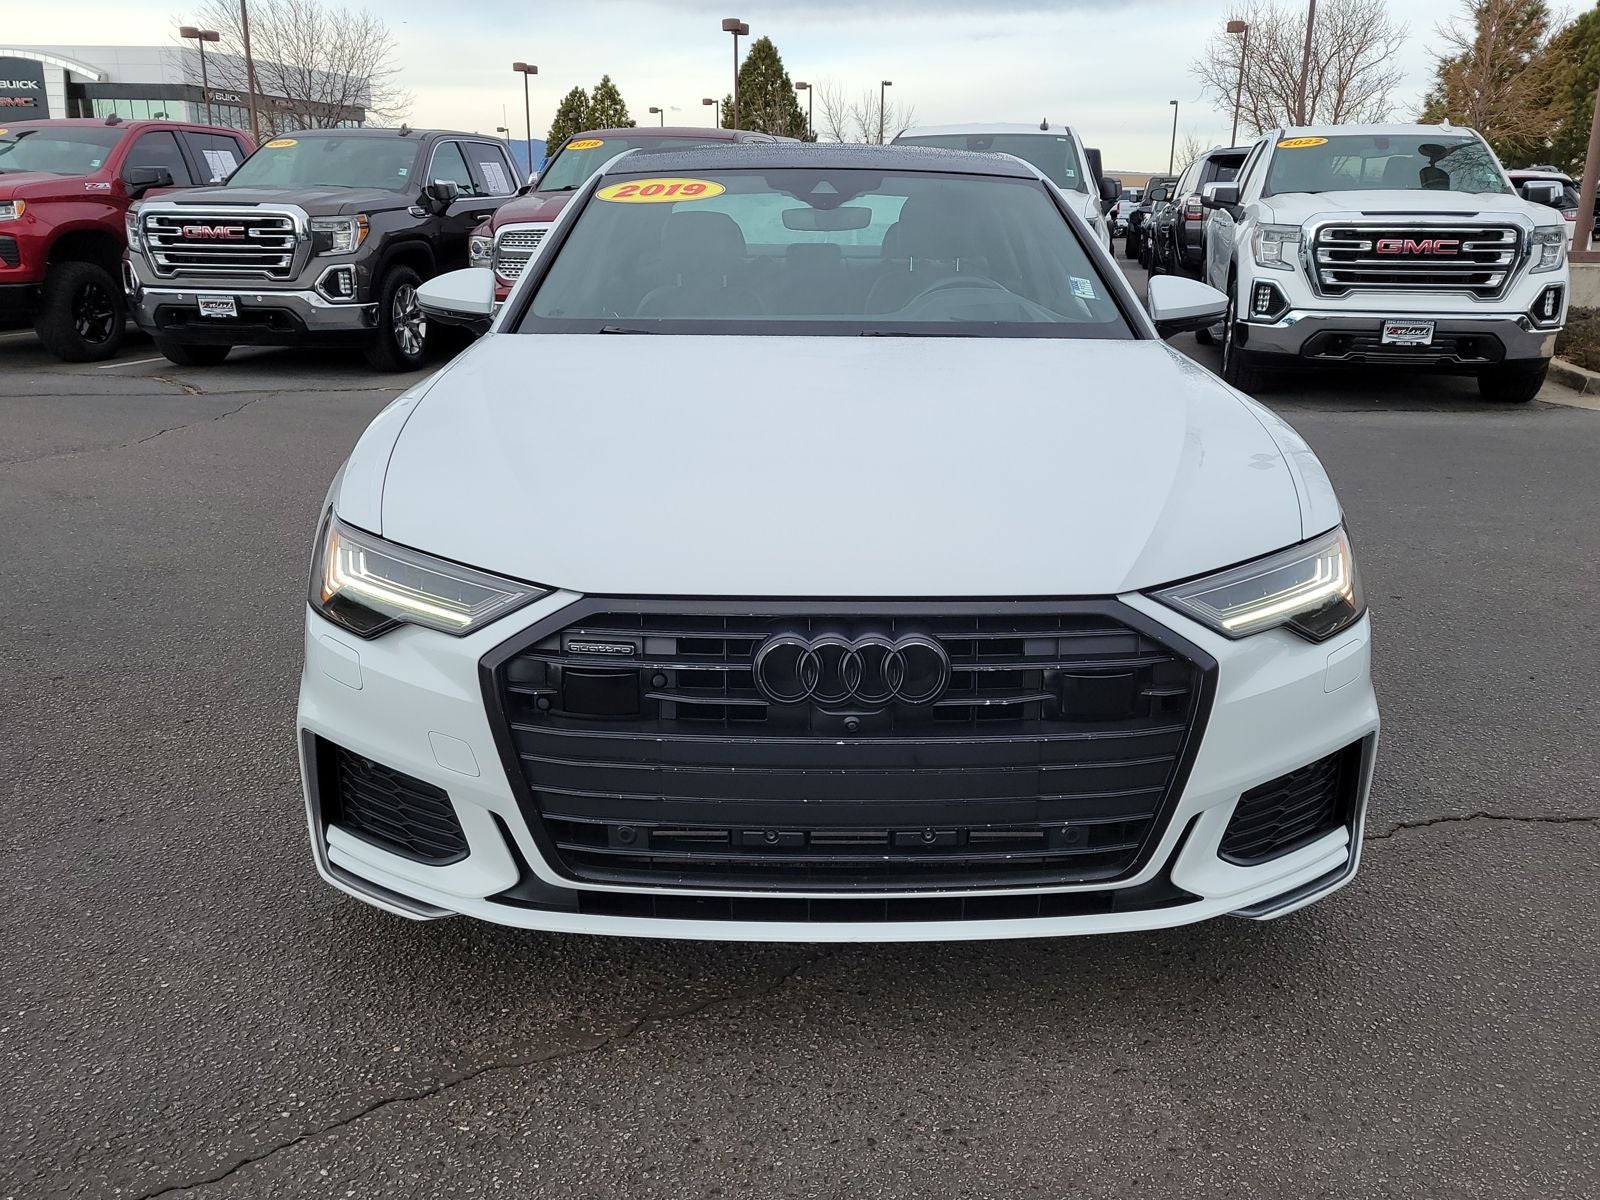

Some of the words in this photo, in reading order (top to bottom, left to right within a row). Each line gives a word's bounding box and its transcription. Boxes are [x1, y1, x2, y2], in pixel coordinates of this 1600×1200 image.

[0, 80, 38, 89] BUICK
[215, 92, 241, 102] BUICK
[1283, 138, 1324, 147] 2022
[612, 183, 707, 198] 2019
[183, 225, 245, 239] GMC
[1377, 239, 1459, 254] GMC
[1386, 326, 1429, 335] Loveland
[570, 645, 631, 653] quattro
